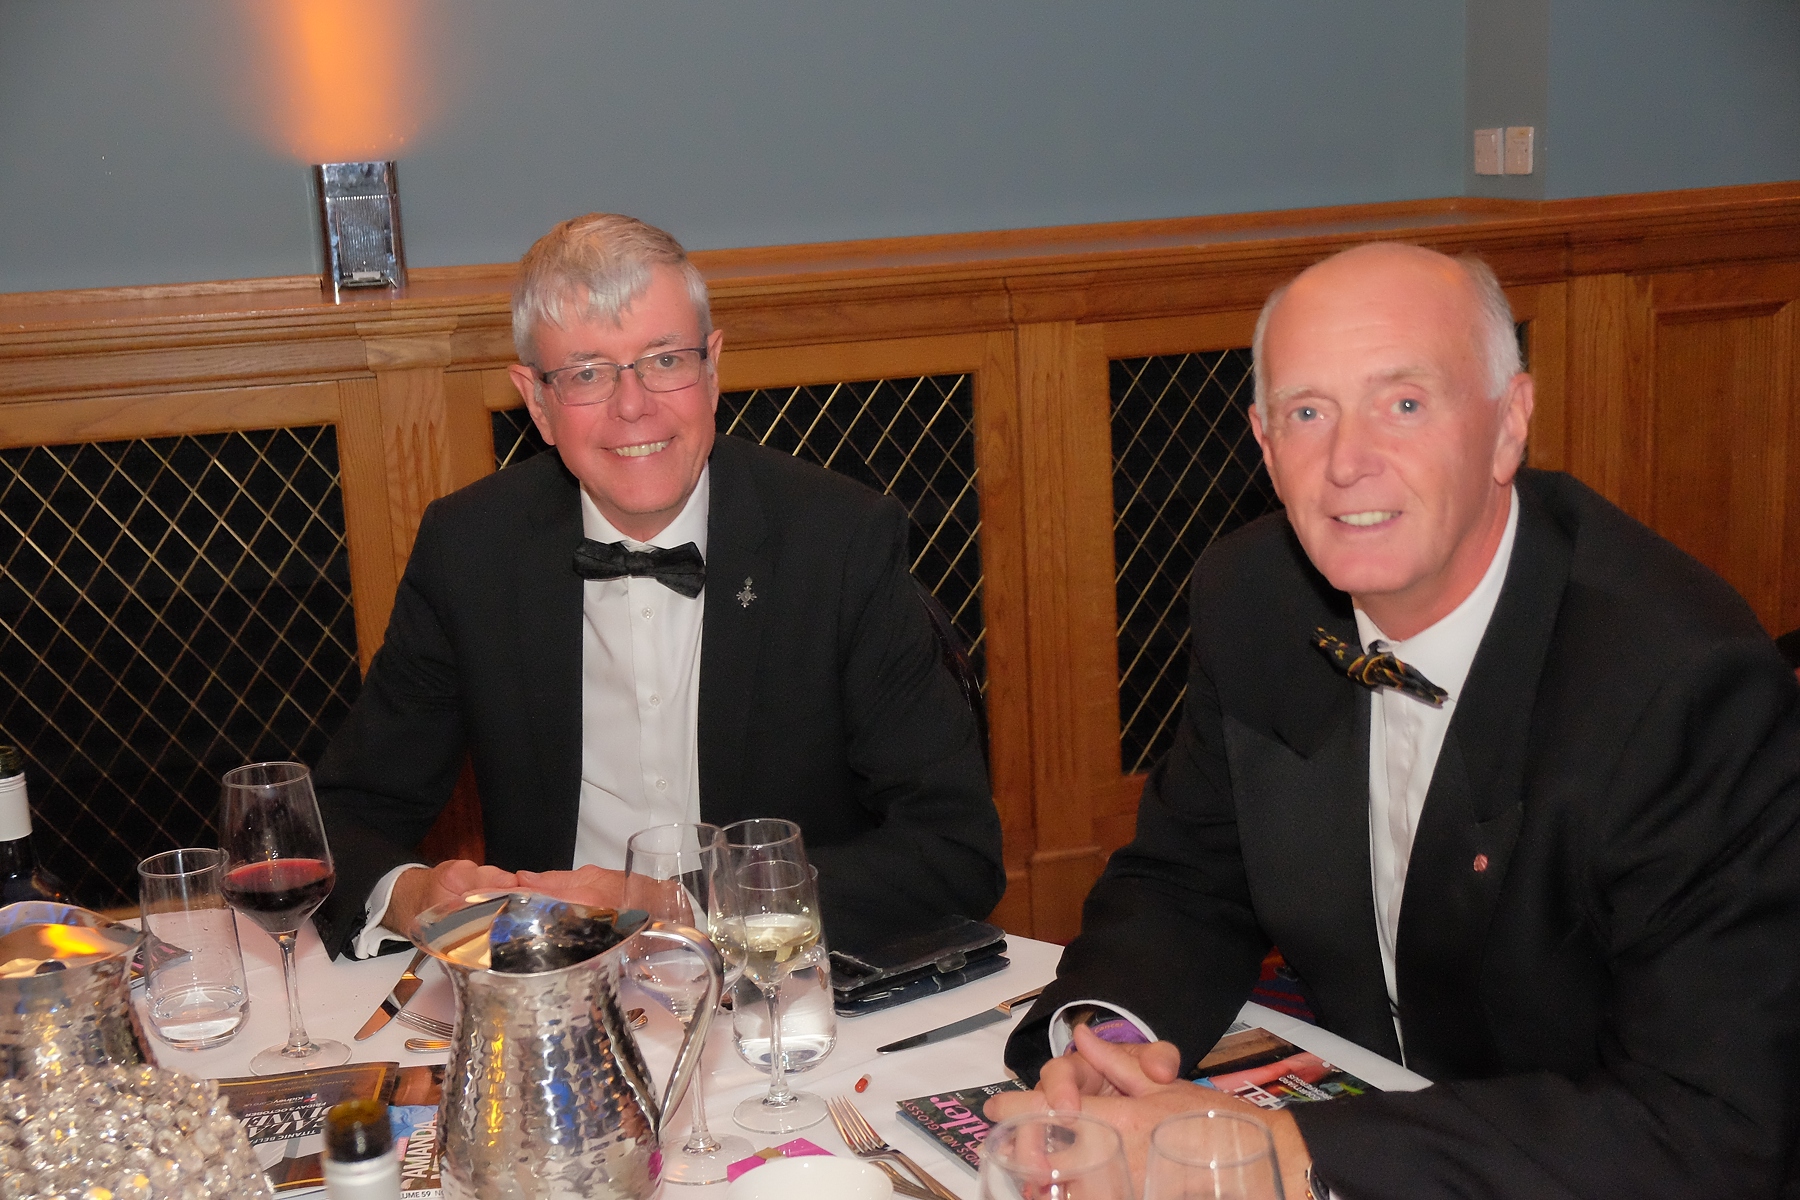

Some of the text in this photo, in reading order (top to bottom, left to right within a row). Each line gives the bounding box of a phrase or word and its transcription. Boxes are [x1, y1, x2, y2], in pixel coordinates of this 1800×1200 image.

[297, 1101, 327, 1110] FRIDAY
[244, 1108, 288, 1117] OCTOBER
[902, 1099, 940, 1131] GLOSSY
[278, 1129, 316, 1141] TITANIC
[401, 1119, 437, 1178] AMANDA
[421, 1190, 431, 1198] 59
